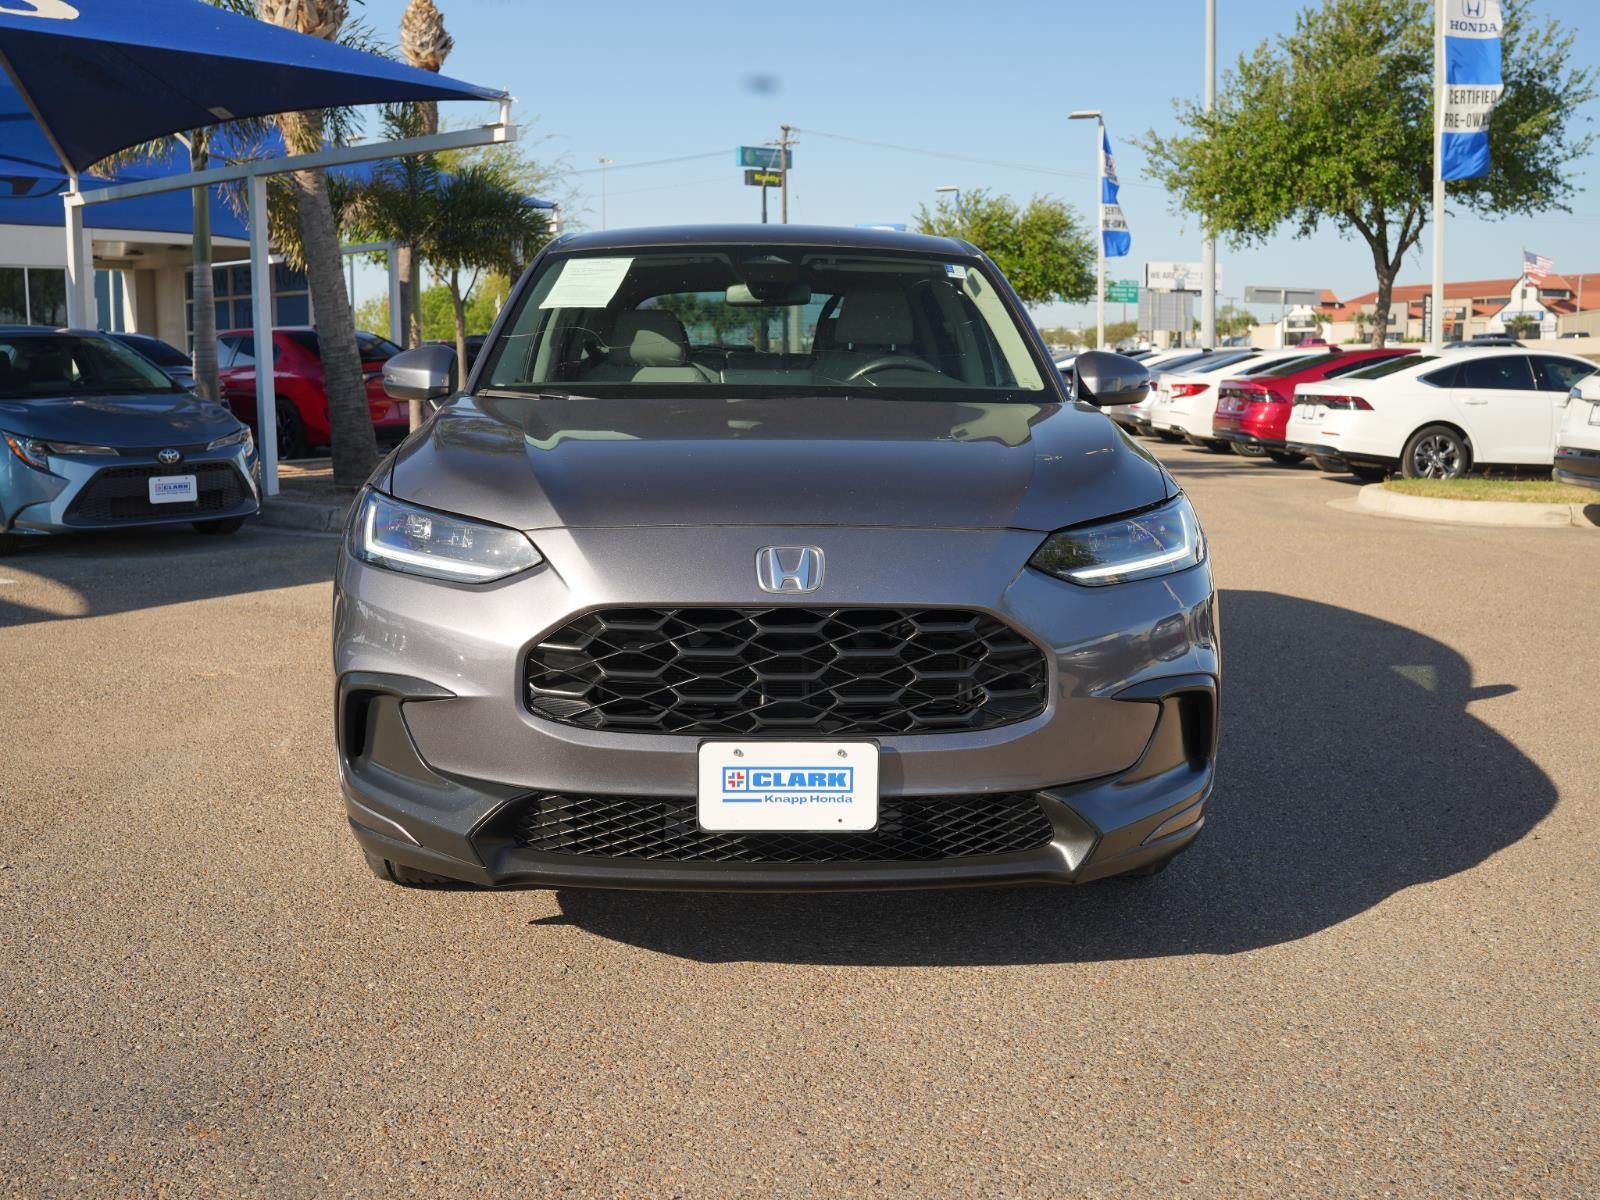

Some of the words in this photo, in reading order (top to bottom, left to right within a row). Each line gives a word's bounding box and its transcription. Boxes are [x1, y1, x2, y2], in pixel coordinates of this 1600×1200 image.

[1450, 20, 1498, 33] HONDA
[1449, 89, 1497, 104] CERTIFIED
[752, 772, 847, 788] CLARK
[764, 794, 808, 805] Knapp
[809, 795, 853, 804] Honda
